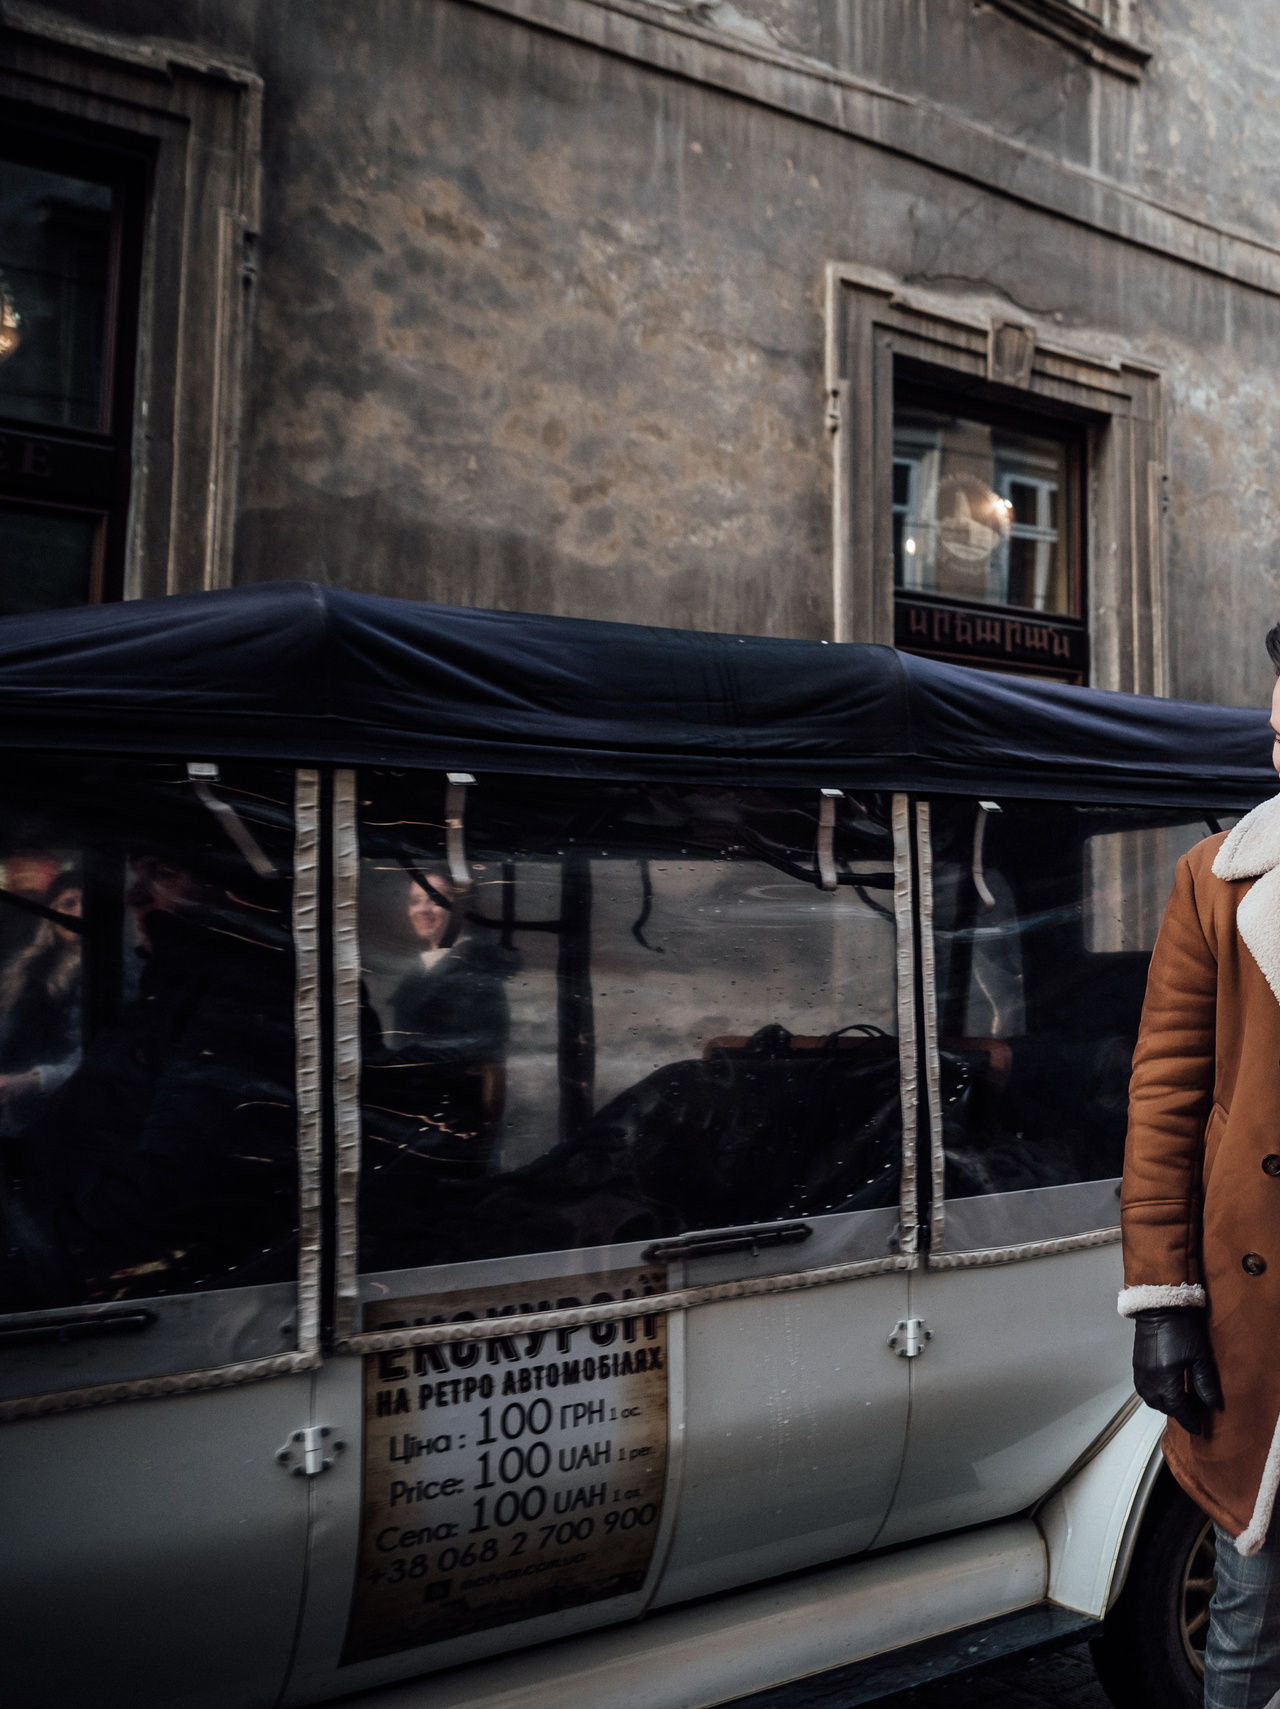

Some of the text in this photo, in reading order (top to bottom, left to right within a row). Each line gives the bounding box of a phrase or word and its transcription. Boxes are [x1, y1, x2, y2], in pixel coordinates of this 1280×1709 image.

[376, 1346, 664, 1417] НА РЕТРО АВТОМОБІЛЯХ
[475, 1397, 554, 1446] 100
[559, 1399, 606, 1430] ГРН
[389, 1477, 465, 1507] Price:
[472, 1441, 551, 1490] 100
[558, 1440, 612, 1472] UAH
[365, 1502, 658, 1586] +38 068 2 700 900
[374, 1522, 461, 1553] Cena:
[468, 1485, 548, 1534] 100
[553, 1483, 607, 1514] UAH
